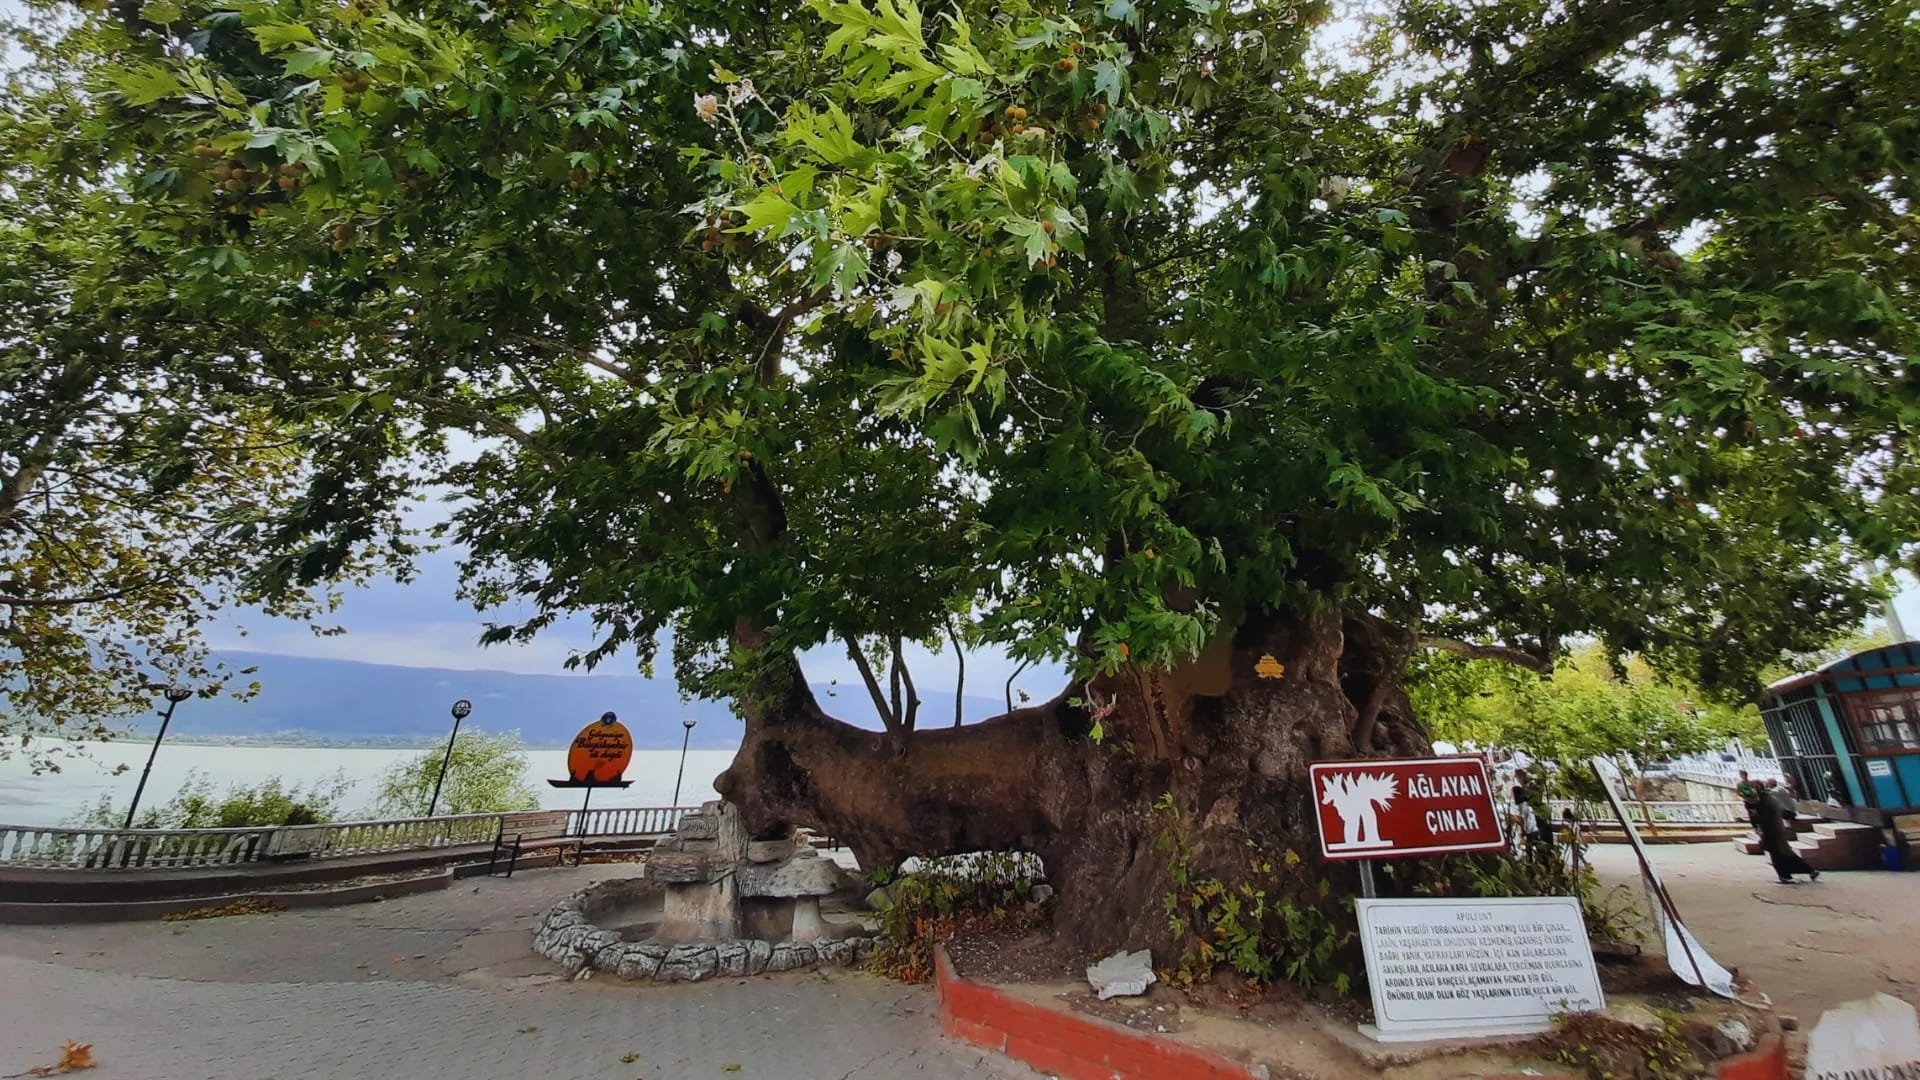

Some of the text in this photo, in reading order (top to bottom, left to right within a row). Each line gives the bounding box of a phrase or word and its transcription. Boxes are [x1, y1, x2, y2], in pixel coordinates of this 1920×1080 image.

[1408, 773, 1482, 798] AĞLAYAN
[1426, 809, 1479, 835] ÇINAR
[1375, 925, 1401, 935] TARİHİN
[1532, 922, 1544, 932] BİR
[1507, 949, 1520, 957] KAN
[1450, 962, 1469, 972] KARA
[1385, 977, 1414, 987] ARDINDA
[1416, 975, 1436, 987] SEVGİ
[1504, 974, 1527, 984] GONCA
[1528, 971, 1539, 983] BİR
[1418, 989, 1436, 1000] OLUK
[1437, 989, 1455, 999] OLUK
[1456, 987, 1471, 998] GÖZ
[1473, 986, 1511, 1000] YAŞLARININ
